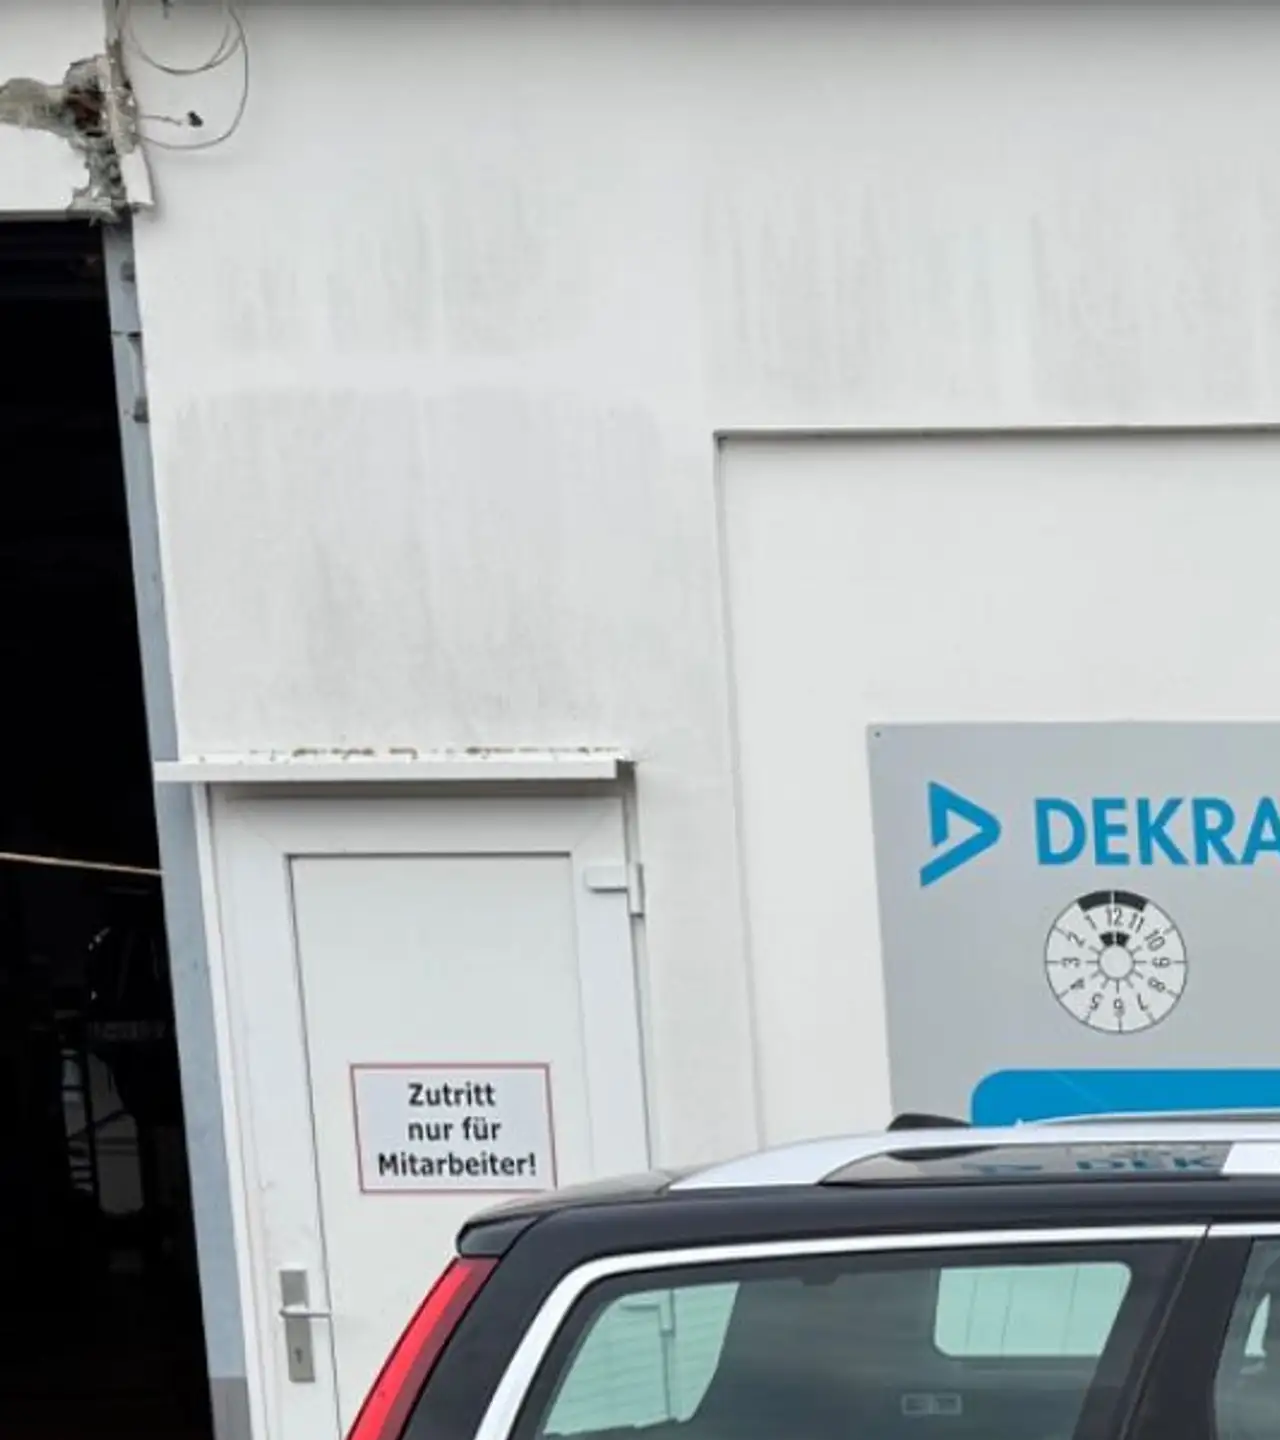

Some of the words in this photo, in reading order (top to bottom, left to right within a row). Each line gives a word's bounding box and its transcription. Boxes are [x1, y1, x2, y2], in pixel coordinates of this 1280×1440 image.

[408, 1080, 497, 1107] Zutritt
[408, 1121, 454, 1142] nur
[461, 1115, 502, 1142] für
[377, 1150, 538, 1177] Mitarbeiter!
